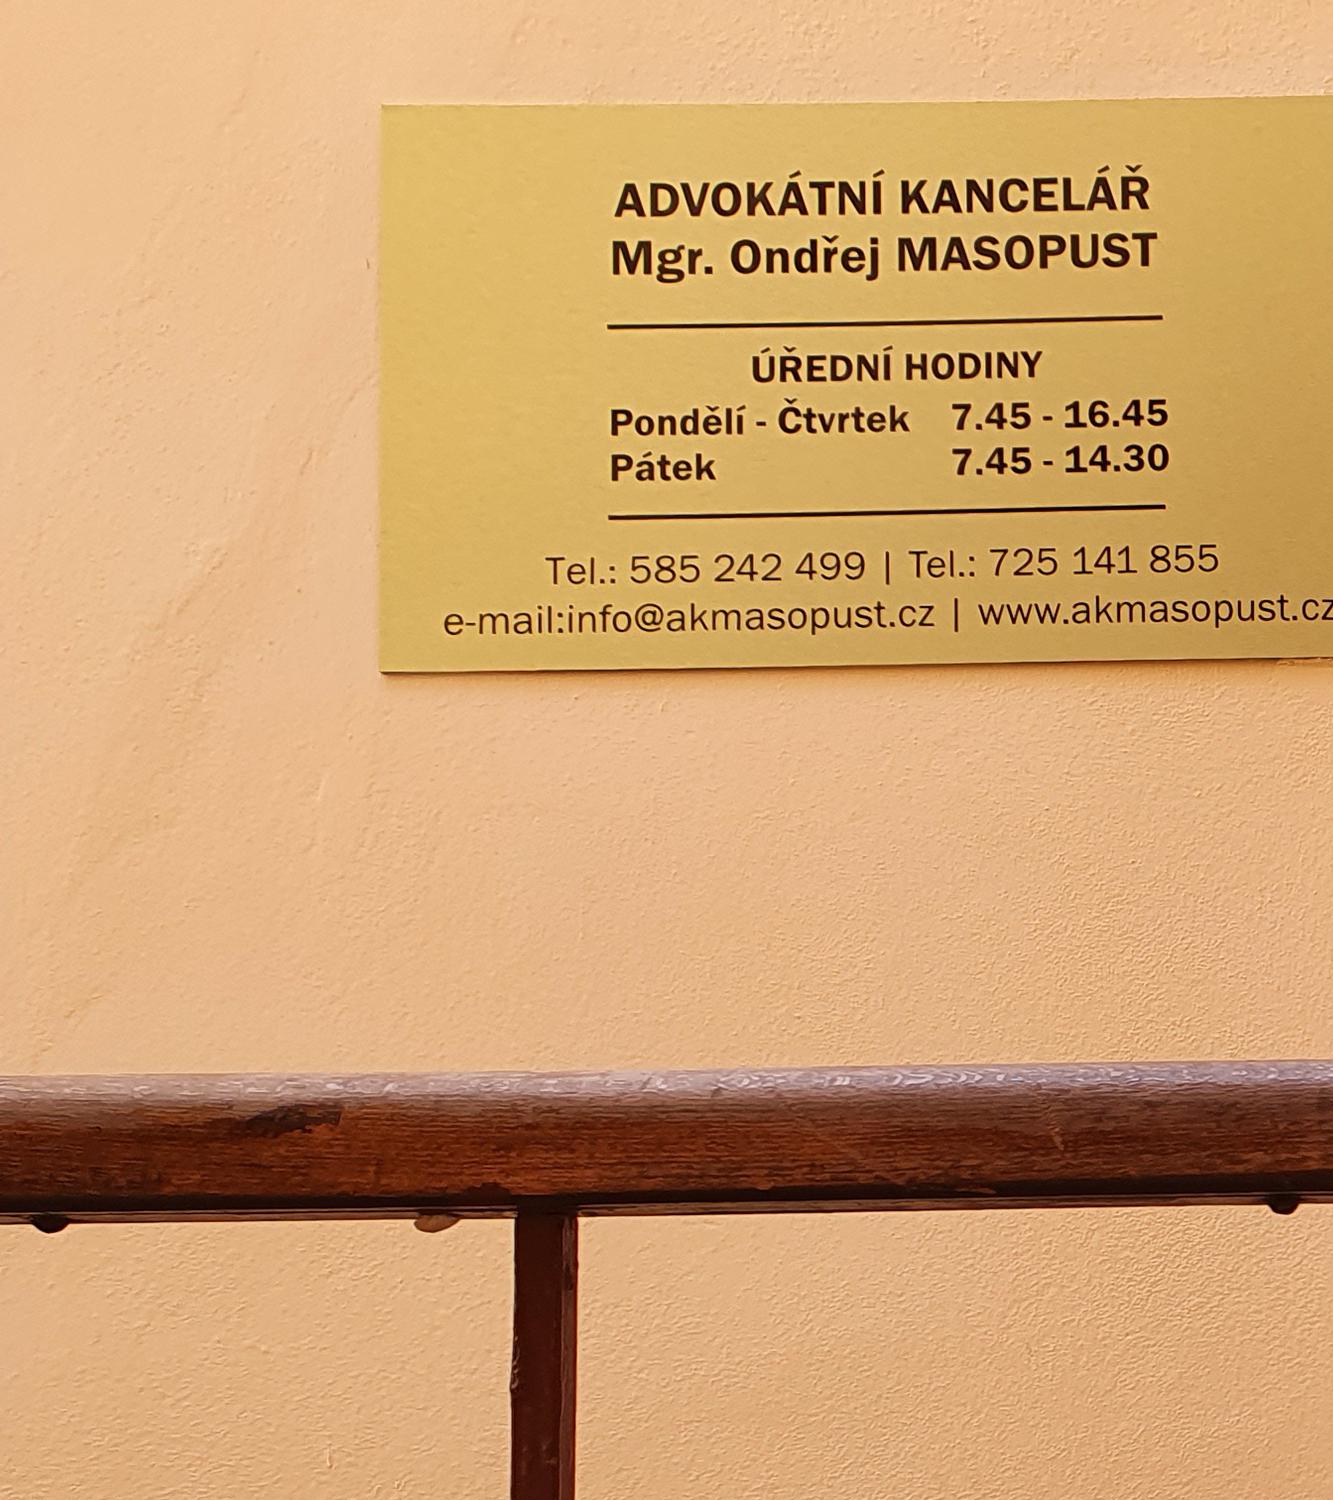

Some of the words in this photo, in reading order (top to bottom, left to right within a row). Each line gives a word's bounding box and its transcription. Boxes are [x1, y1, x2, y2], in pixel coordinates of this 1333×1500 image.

[614, 168, 886, 218] ADVOKÁTNÍ
[900, 163, 1151, 215] KANCELÁŘ
[612, 239, 714, 284] Mgr.
[730, 235, 880, 282] Ondřej
[897, 232, 1159, 272] MASOPUST
[752, 345, 893, 384] ÚŘEDNÍ
[905, 350, 1044, 381] HODINY
[610, 404, 746, 437] Pondělí
[778, 397, 910, 435] Čtvrtek
[951, 402, 1032, 431] 7.45
[1064, 398, 1169, 429] 16.45
[611, 451, 717, 482] Pátek
[951, 446, 1032, 476] 7.45
[1064, 443, 1170, 474] 14.30
[545, 556, 616, 585] Tel.:
[630, 555, 701, 584] 585
[714, 553, 782, 583] 242
[795, 551, 866, 581] 499
[908, 549, 975, 579] Tel.:
[989, 547, 1058, 577] 725
[1073, 545, 1138, 575] 141
[1149, 544, 1219, 574] 855
[443, 600, 935, 637] e-mail:info@akmasopust.cz
